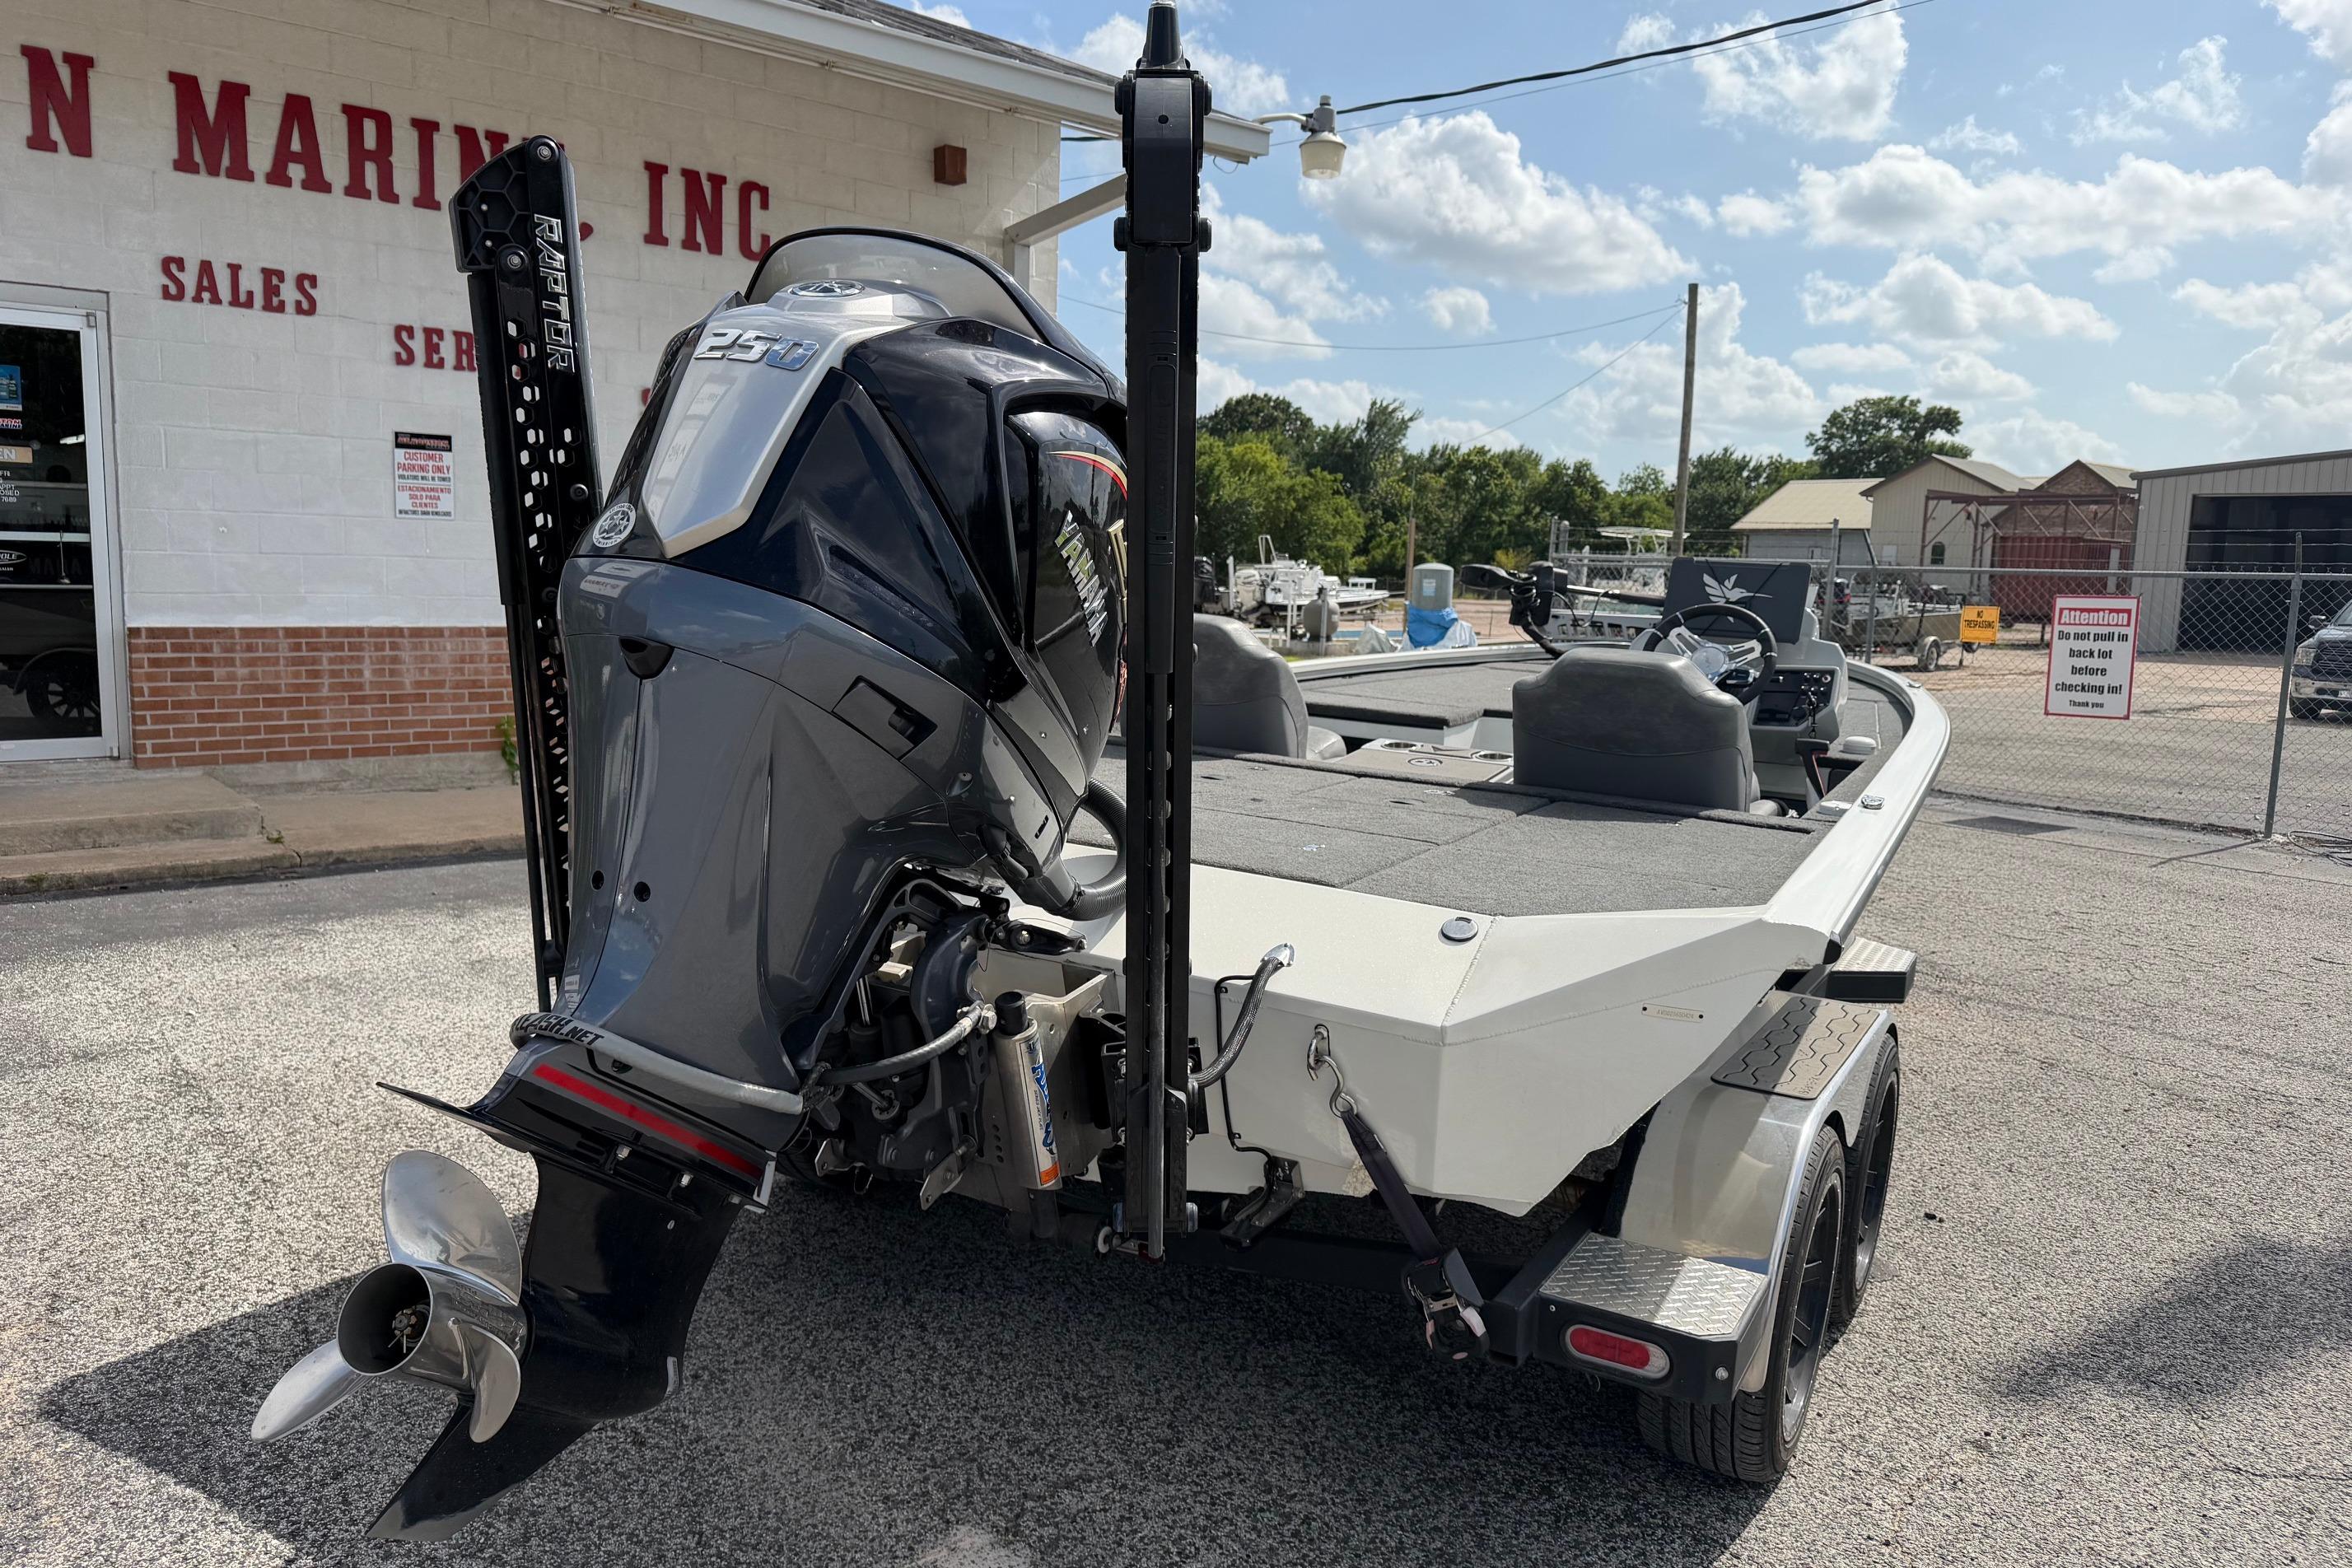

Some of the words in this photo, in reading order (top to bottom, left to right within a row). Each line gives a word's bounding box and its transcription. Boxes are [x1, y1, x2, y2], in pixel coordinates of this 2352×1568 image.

[644, 161, 771, 262] INC
[161, 255, 318, 316] SALES
[534, 213, 575, 374] RAPTOR
[693, 329, 820, 371] 250
[404, 450, 444, 463] CUSTOMER
[397, 462, 430, 474] PARKING
[432, 464, 450, 474] ONLY
[1054, 510, 1108, 647] YAMAHA
[1976, 610, 1983, 618] NO
[2060, 609, 2128, 625] Attention
[1964, 619, 1995, 629] TRESPASSING
[2058, 630, 2070, 641] Do
[2073, 631, 2090, 642] not
[2093, 631, 2115, 643] pull
[2117, 632, 2129, 642] in
[2069, 647, 2095, 659] back
[2098, 648, 2112, 659] lot
[2071, 665, 2107, 676] before
[2055, 682, 2104, 695] checking
[2107, 684, 2122, 694] in!
[2069, 699, 2089, 708] Thank
